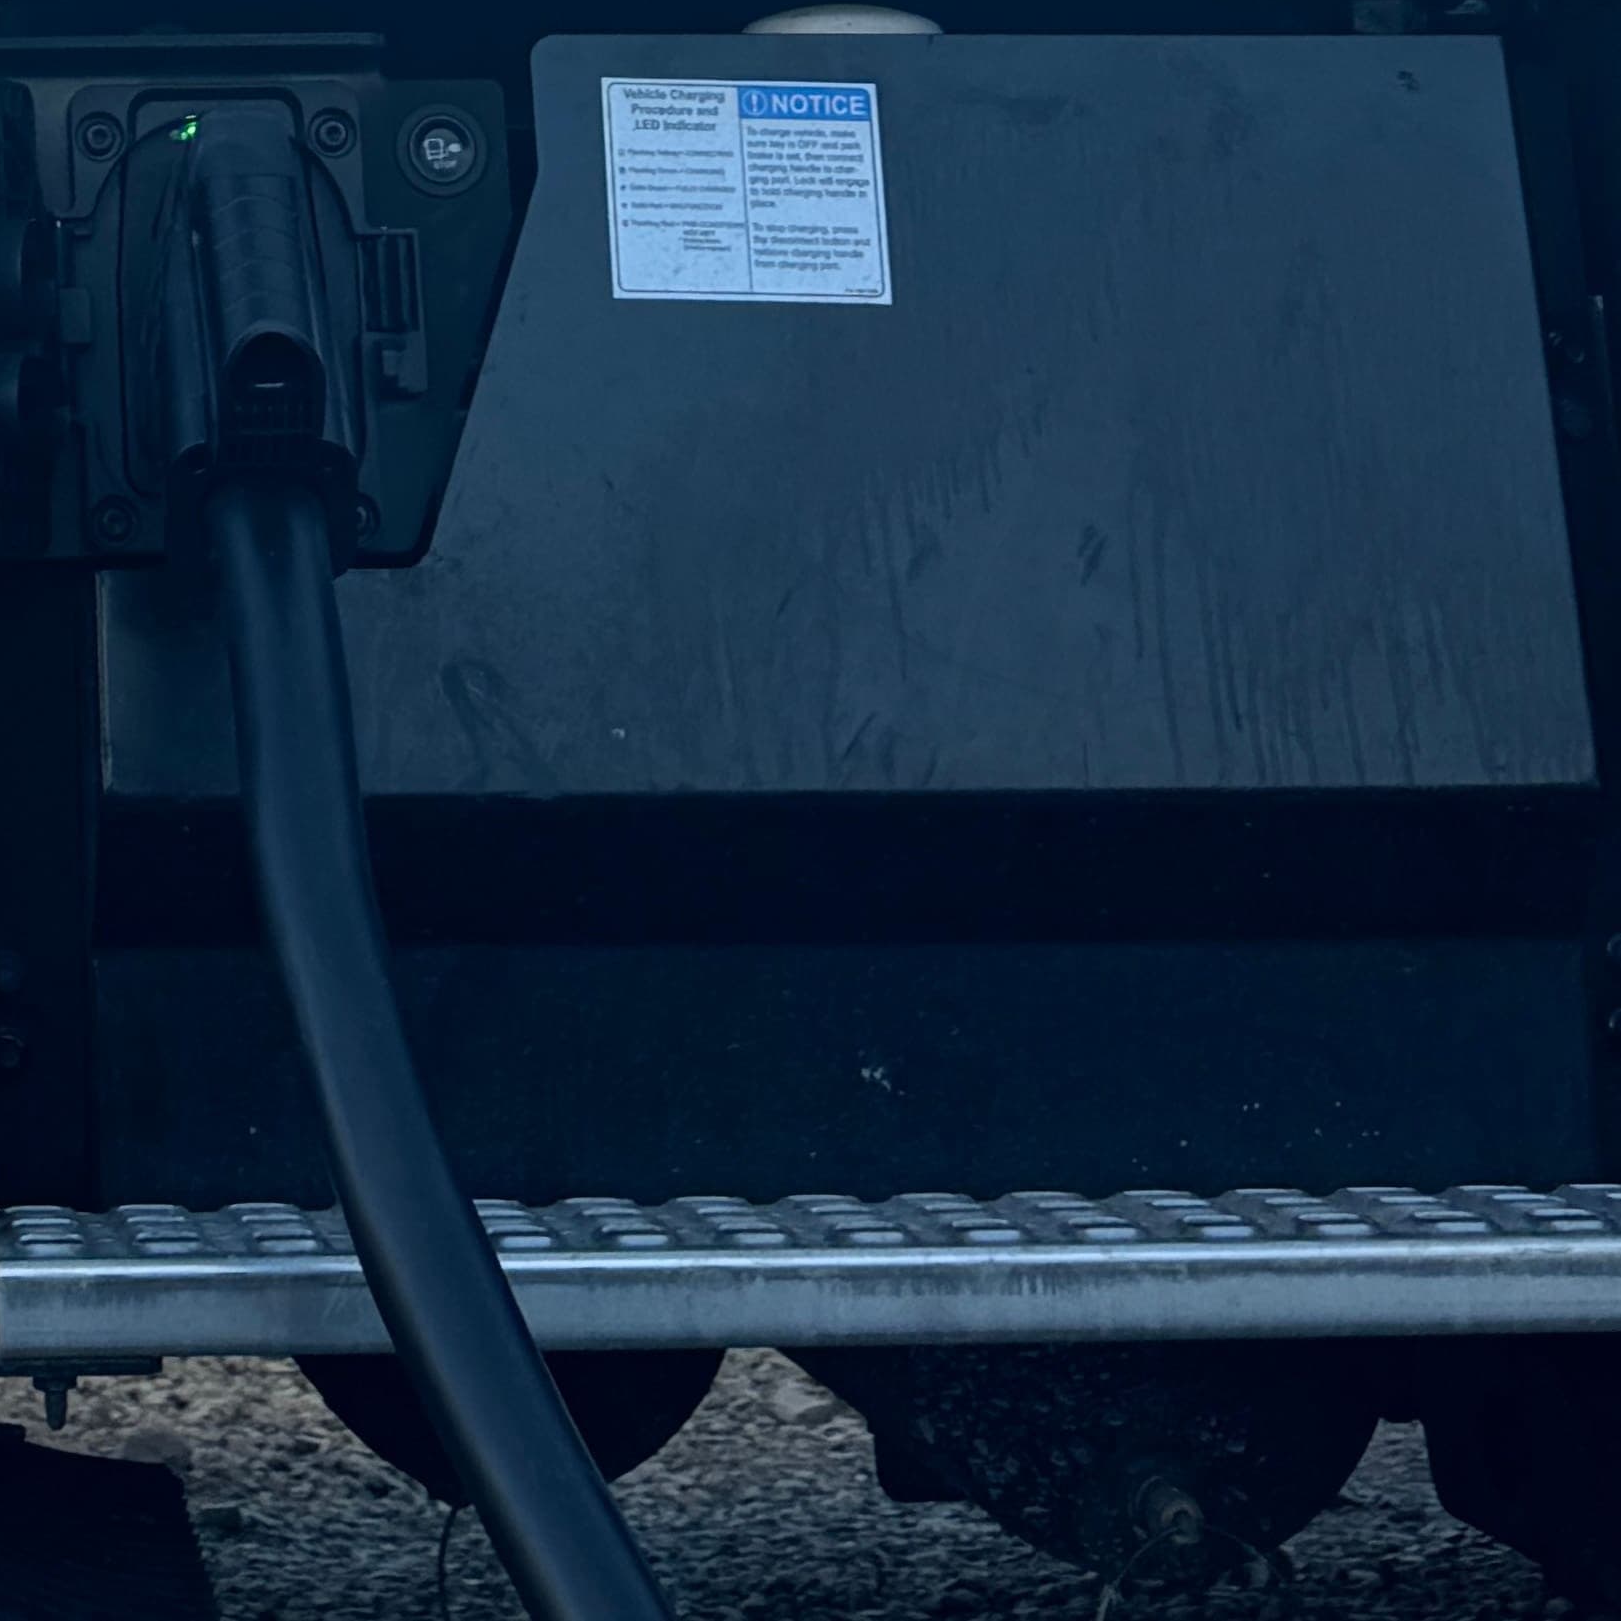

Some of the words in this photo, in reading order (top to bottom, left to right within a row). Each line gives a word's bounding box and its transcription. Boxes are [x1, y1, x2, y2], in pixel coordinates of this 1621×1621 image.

[623, 88, 667, 100] Vehicle
[670, 89, 725, 103] Charging
[631, 103, 692, 116] Procedure
[696, 105, 719, 116] and
[771, 93, 868, 115] NOTICE
[663, 120, 716, 131] Indicator
[760, 127, 791, 138] charge
[798, 140, 818, 149] OFF
[821, 141, 839, 150] and
[748, 163, 788, 174] charging
[783, 188, 823, 199] charging
[791, 248, 831, 259] charging
[778, 260, 818, 271] charging
